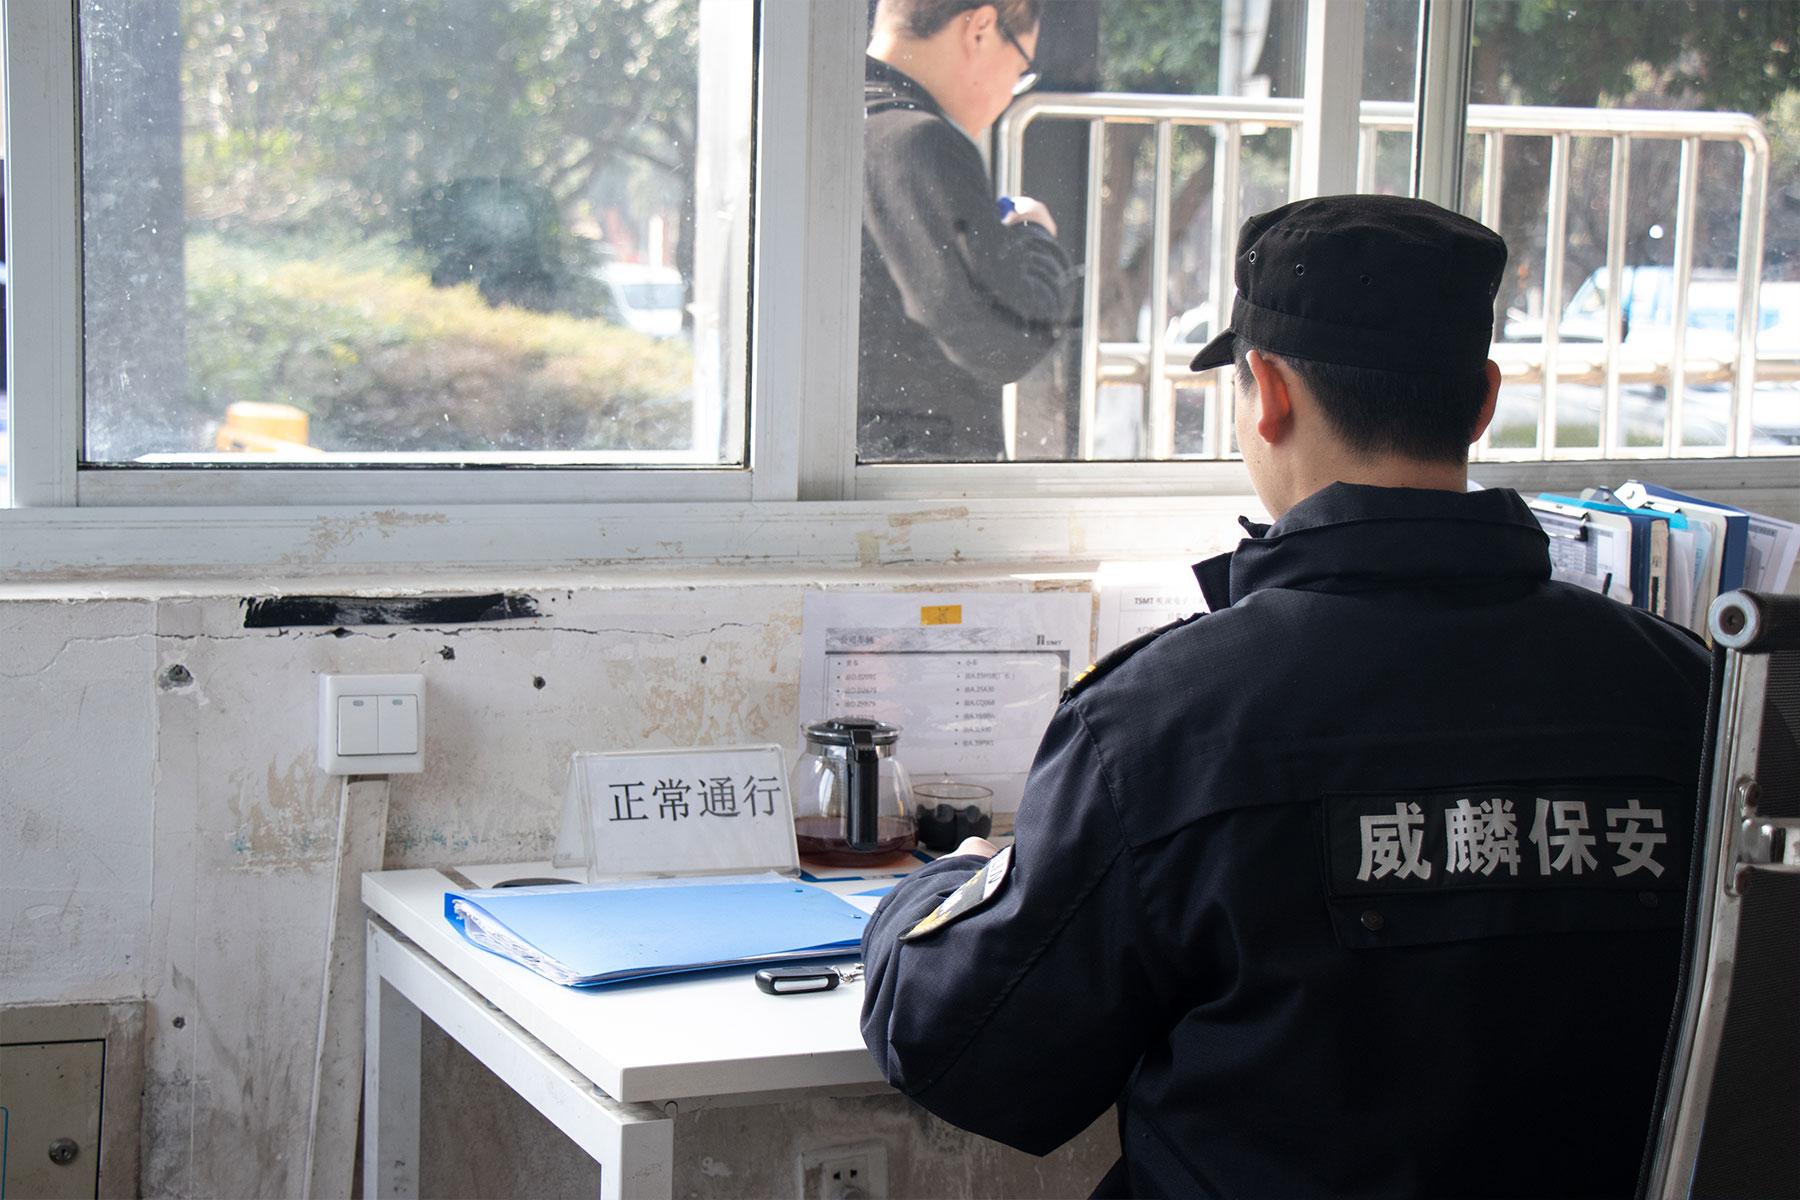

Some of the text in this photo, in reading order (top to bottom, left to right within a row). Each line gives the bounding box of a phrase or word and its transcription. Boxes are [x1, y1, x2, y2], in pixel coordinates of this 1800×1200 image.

[1134, 597, 1154, 605] TSMT
[608, 775, 782, 822] 正常通行
[1356, 798, 1667, 882] 威麟保安
